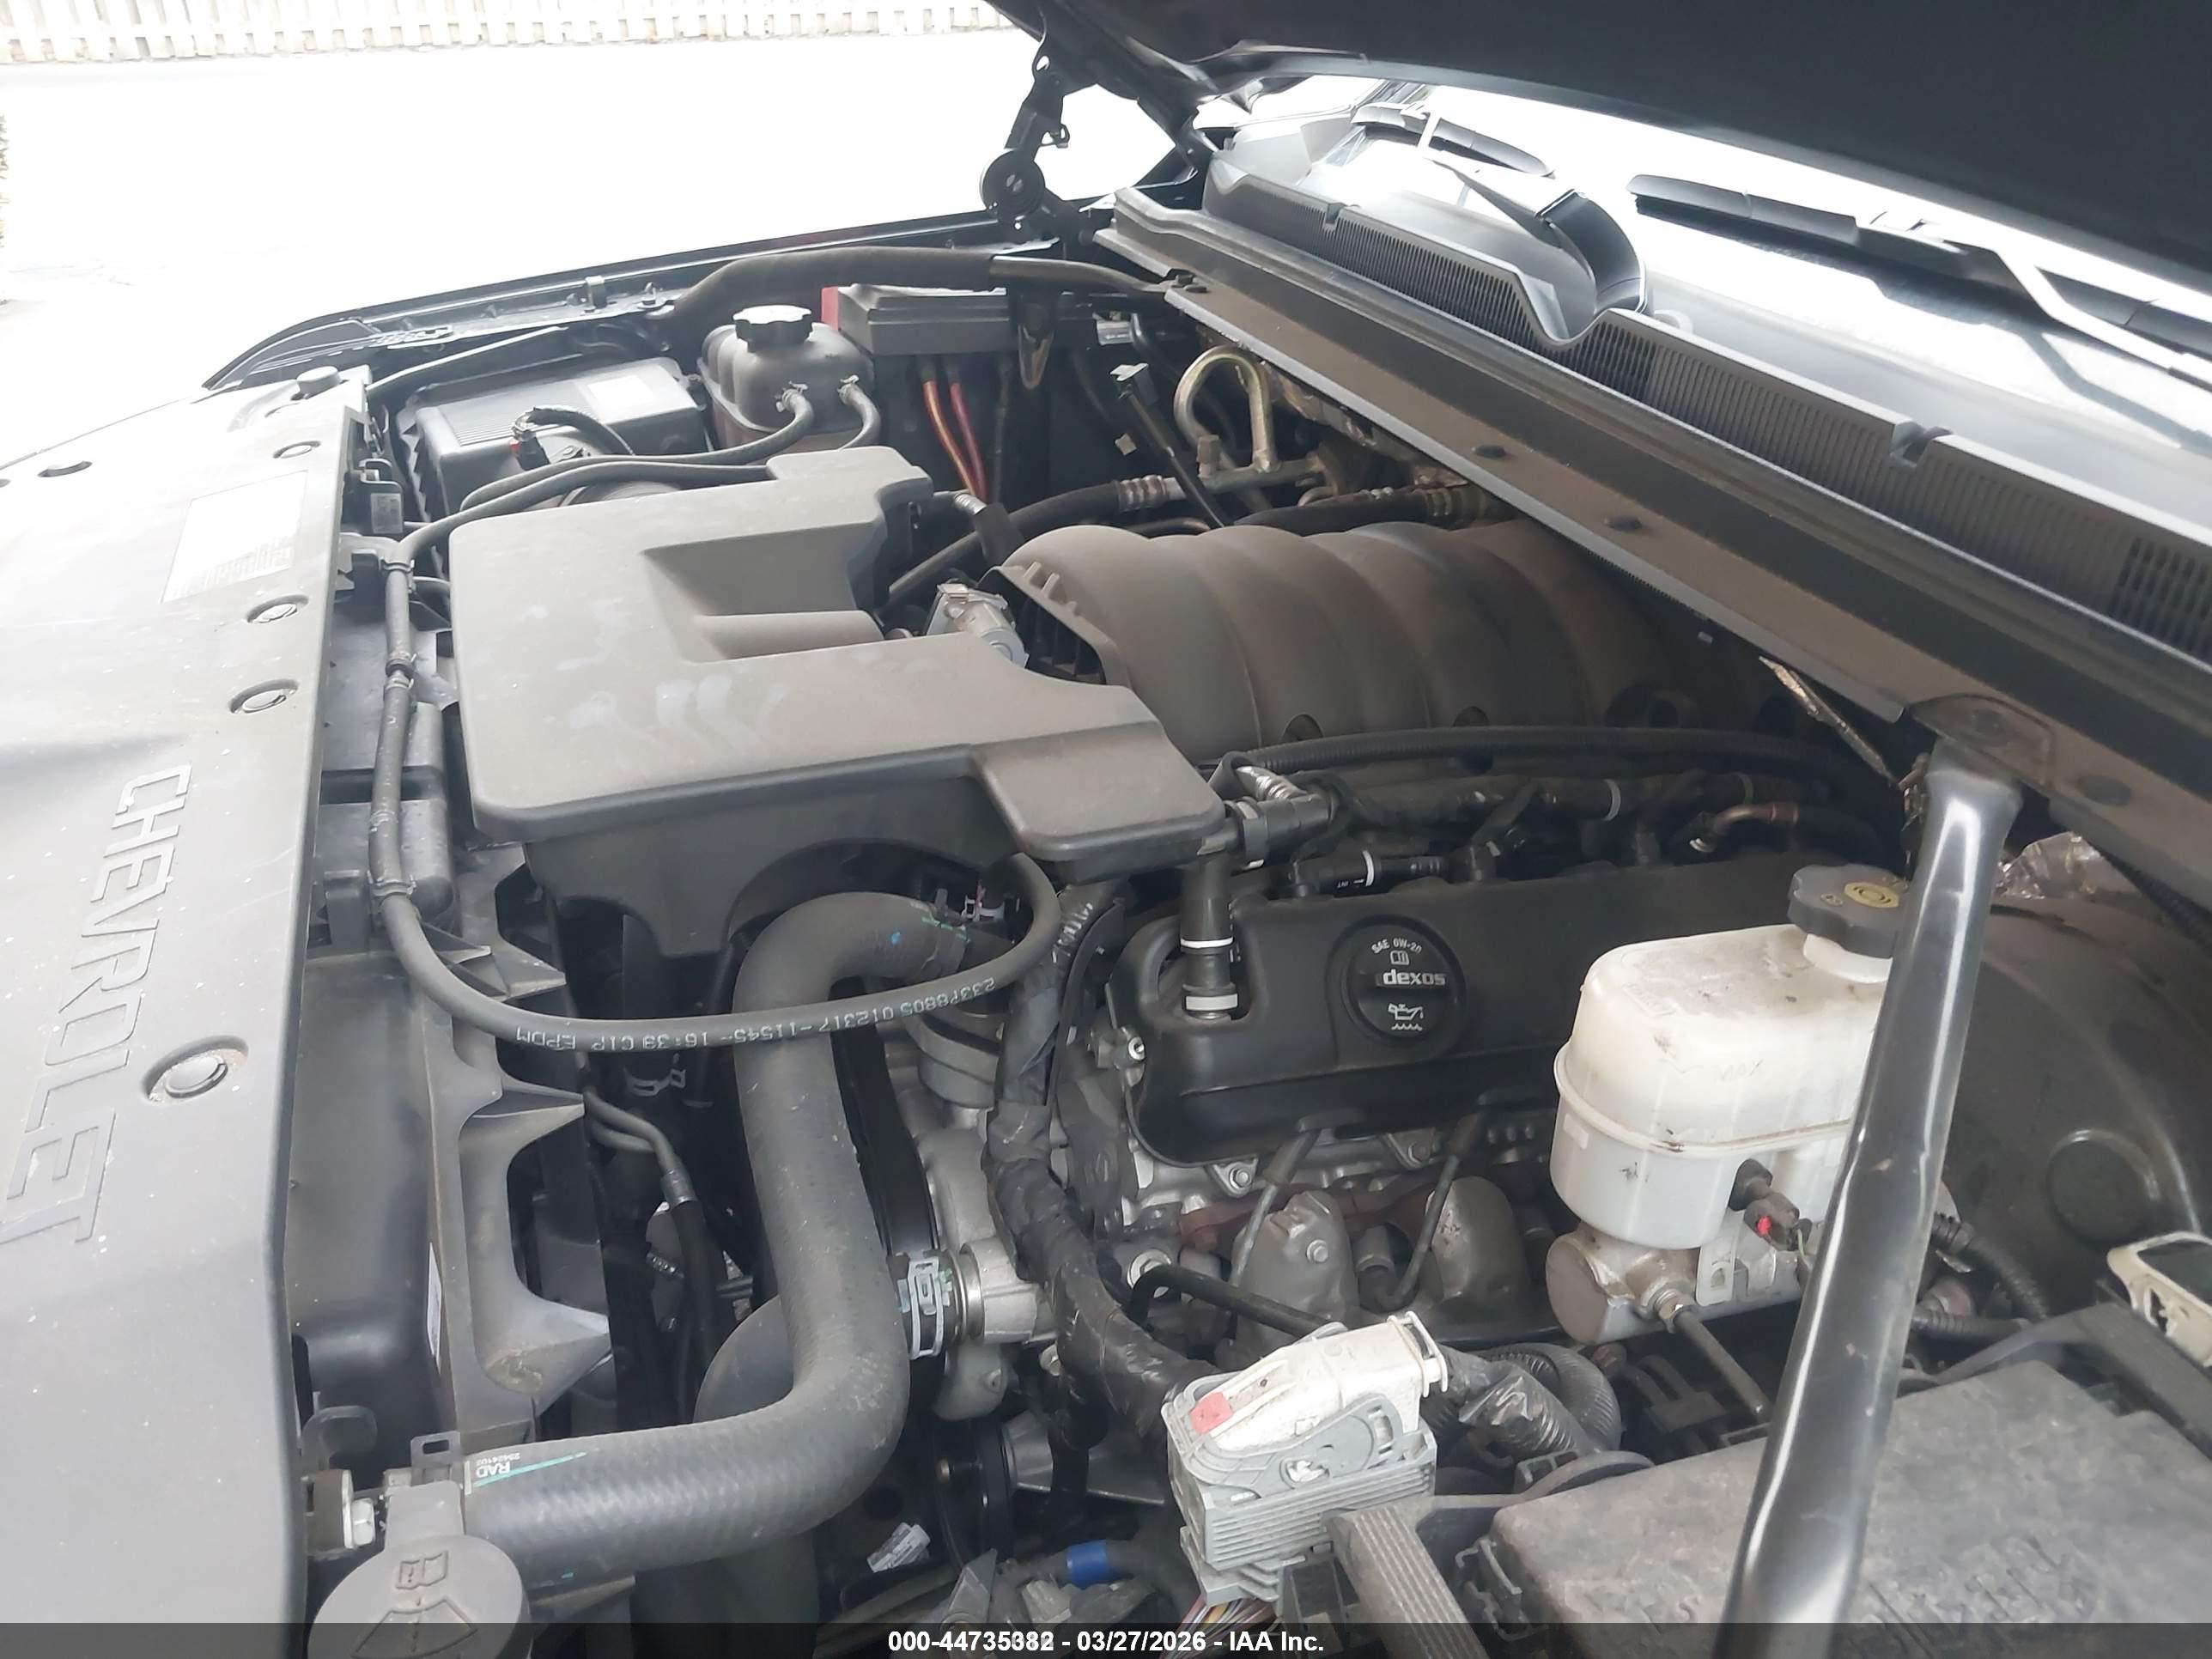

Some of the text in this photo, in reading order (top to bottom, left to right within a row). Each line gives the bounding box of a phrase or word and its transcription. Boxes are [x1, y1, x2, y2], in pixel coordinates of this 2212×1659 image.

[1371, 938, 1422, 954] SAE 0W-20
[1382, 969, 1446, 986] dexos
[0, 763, 192, 1244] CHEVROLET
[516, 1026, 576, 1051] EPDM
[476, 1461, 511, 1478] RAD
